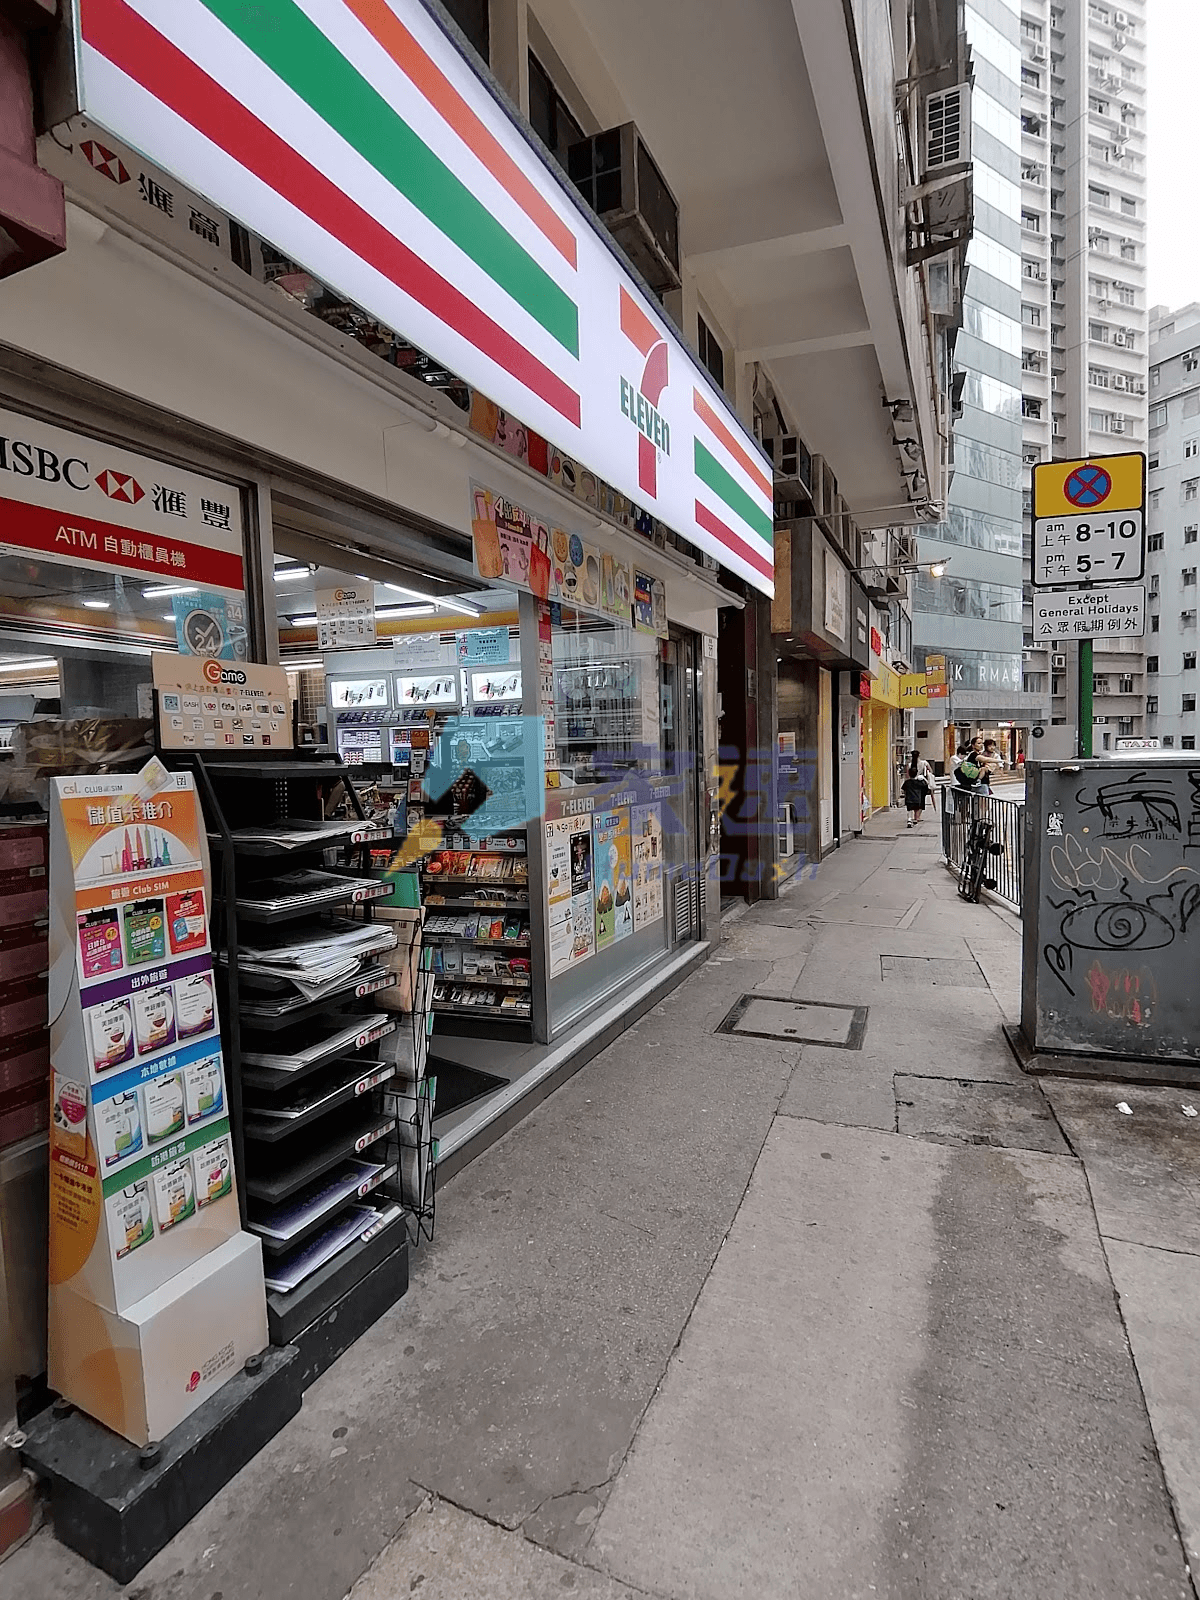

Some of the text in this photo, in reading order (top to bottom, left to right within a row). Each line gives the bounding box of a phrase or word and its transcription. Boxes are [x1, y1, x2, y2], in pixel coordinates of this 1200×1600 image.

[0, 436, 91, 492] SBC
[1046, 522, 1065, 533] am
[1075, 519, 1137, 543] 8-10
[55, 526, 98, 550] ATM
[1040, 533, 1071, 548] 上午
[104, 535, 187, 569] 自動櫃員機
[1046, 552, 1065, 564] pm
[1040, 564, 1071, 578] 下午
[1068, 592, 1109, 606] Except
[1039, 603, 1139, 618] General Holidays
[1040, 618, 1138, 635] 公眾假期例外
[195, 634, 216, 652] 24
[204, 660, 246, 685] Game
[1122, 740, 1157, 748] TAXI
[84, 785, 103, 794] CLUB
[86, 801, 174, 826] 儲值卡推介
[1155, 833, 1179, 841] BILL
[132, 883, 152, 895] Club
[153, 881, 170, 891] SIM
